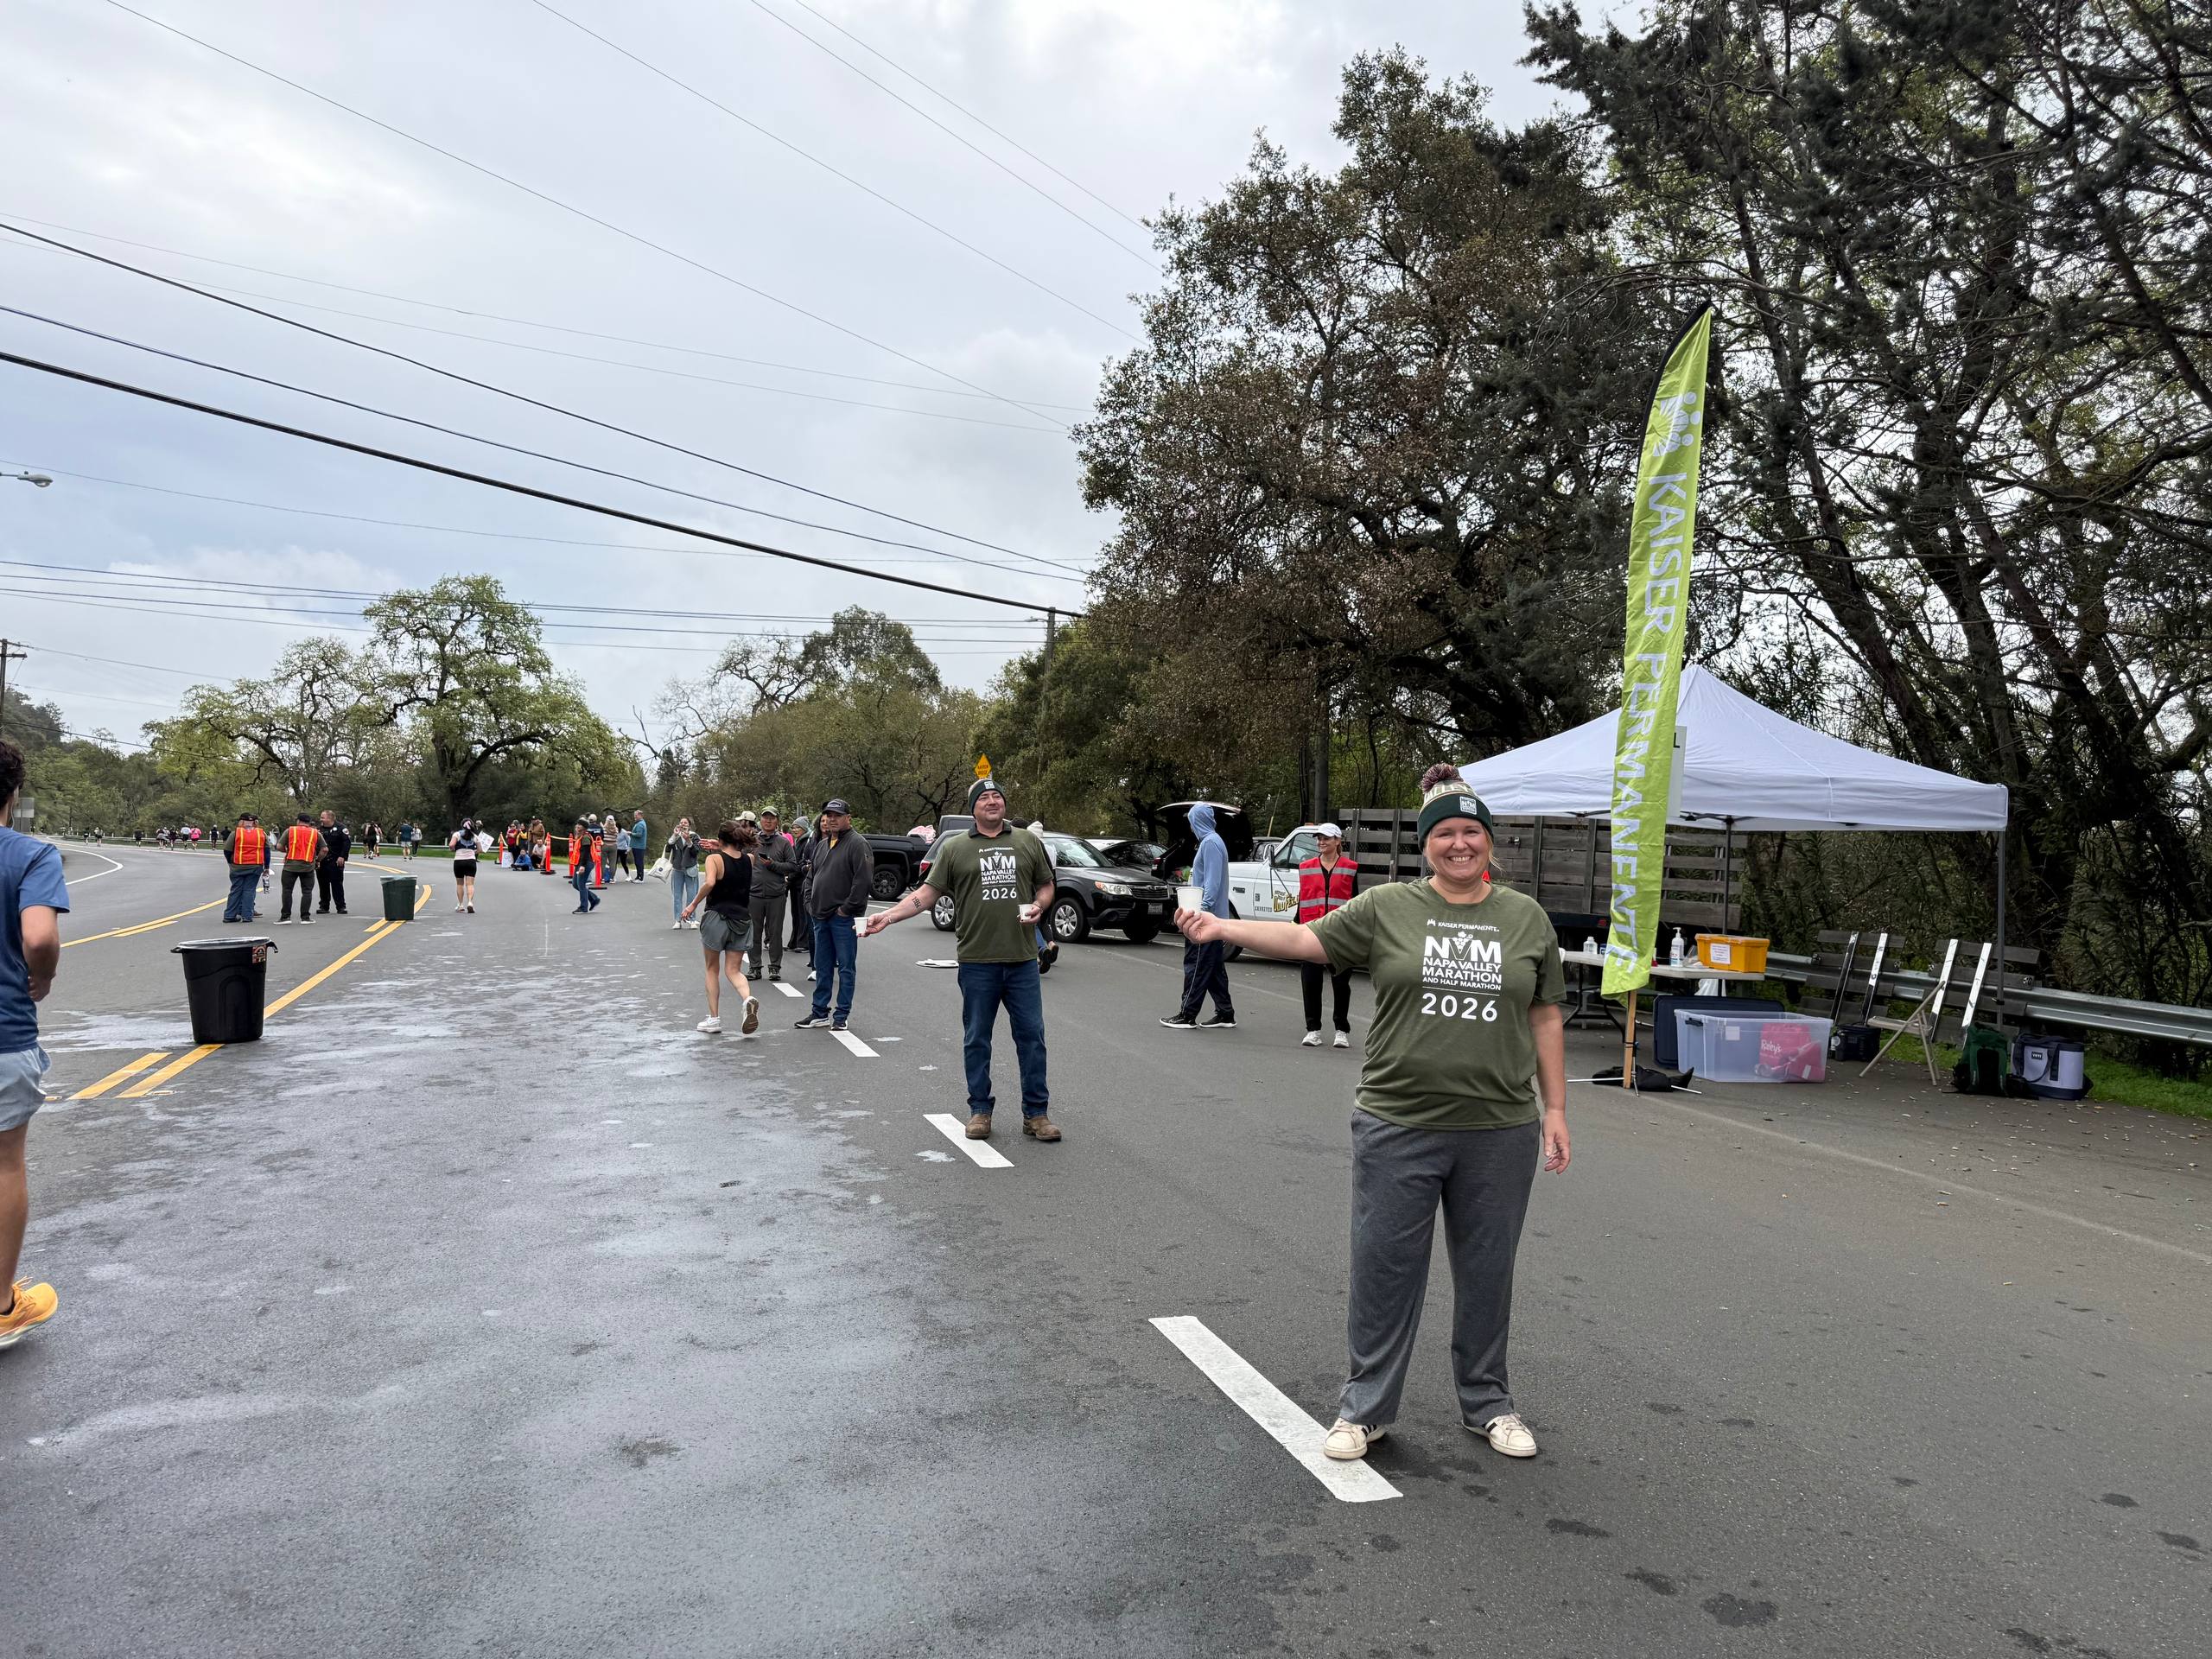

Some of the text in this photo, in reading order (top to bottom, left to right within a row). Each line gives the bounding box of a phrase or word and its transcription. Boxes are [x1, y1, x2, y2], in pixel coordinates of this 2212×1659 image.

[1603, 473, 1687, 973] KAISER PERMANENTE
[979, 855, 1016, 871] NVM
[982, 887, 1017, 900] 2026
[1424, 935, 1502, 963] NVM
[1423, 957, 1502, 973] NAPA VALLEY
[1422, 966, 1502, 983] MARATHON
[1460, 981, 1502, 991] MARATHON
[1421, 992, 1497, 1022] 2026
